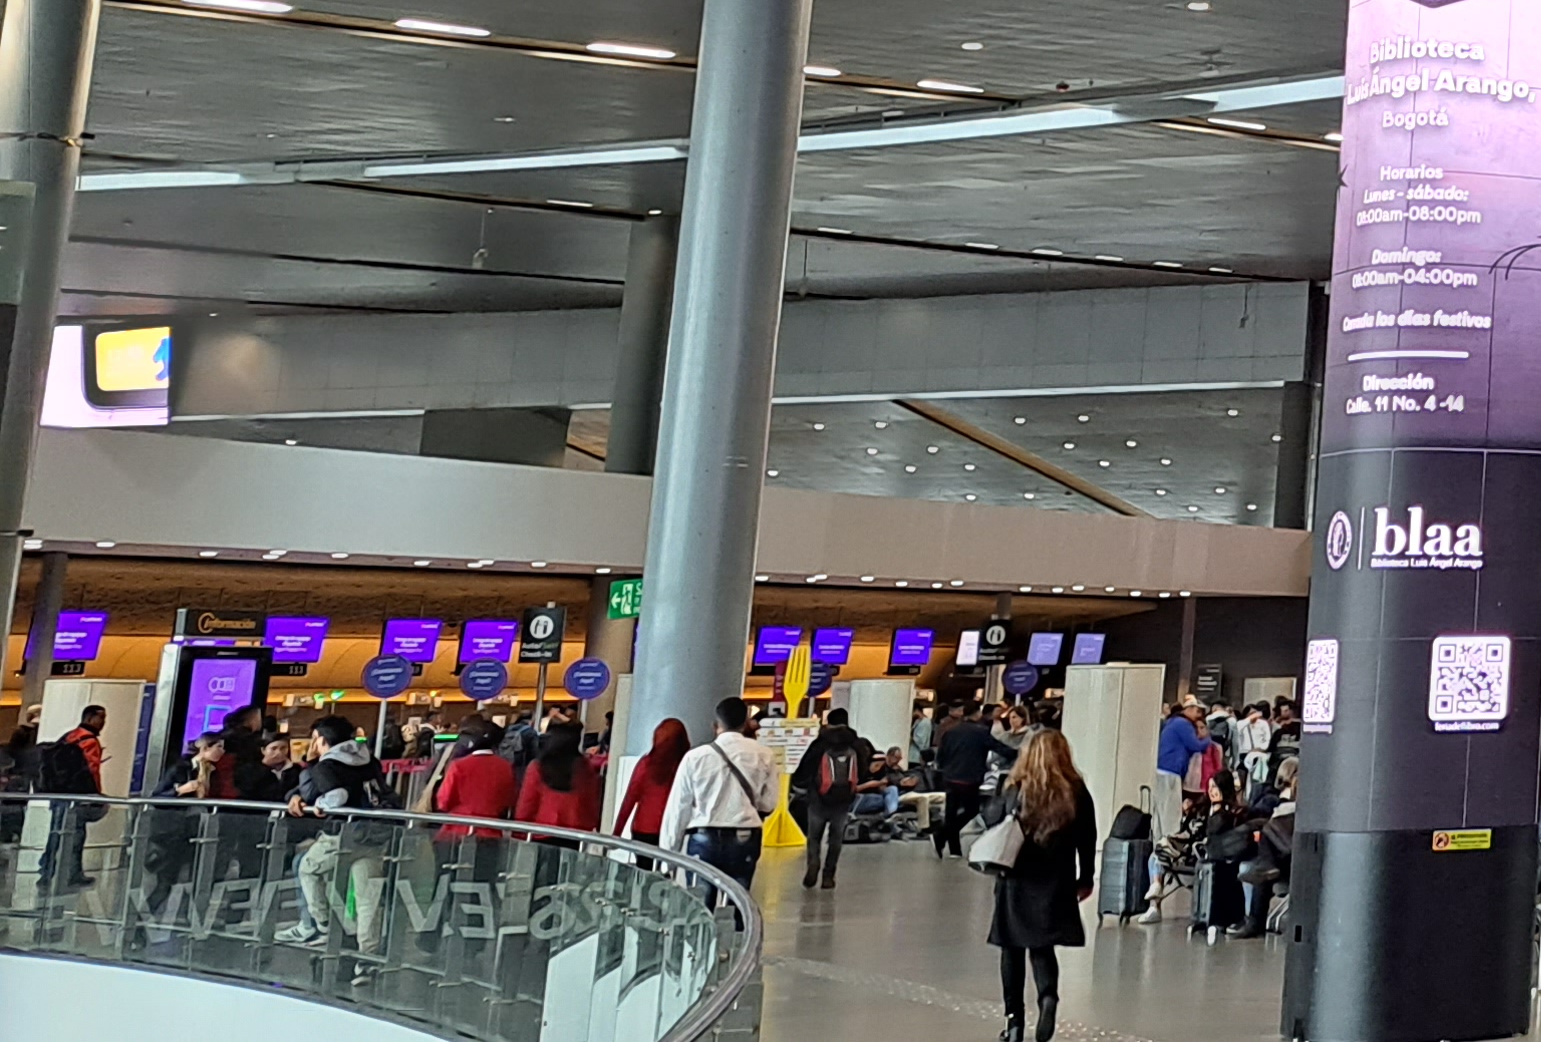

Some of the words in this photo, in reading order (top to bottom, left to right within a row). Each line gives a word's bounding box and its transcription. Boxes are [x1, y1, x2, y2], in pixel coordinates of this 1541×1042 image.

[1369, 35, 1485, 64] Biblioteca
[1347, 80, 1369, 105] Luis
[1369, 67, 1430, 99] Ángel
[1433, 69, 1537, 104] Arango,
[1382, 108, 1450, 131] Bogotá
[1380, 164, 1444, 182] Horarios
[1363, 189, 1395, 205] Lunes
[1406, 184, 1470, 202] sábado:
[1371, 246, 1442, 267] Domingo:
[1433, 309, 1491, 329] festivos
[1363, 373, 1435, 391] Dirección
[1392, 395, 1421, 412] No.
[1371, 506, 1483, 556] blaa
